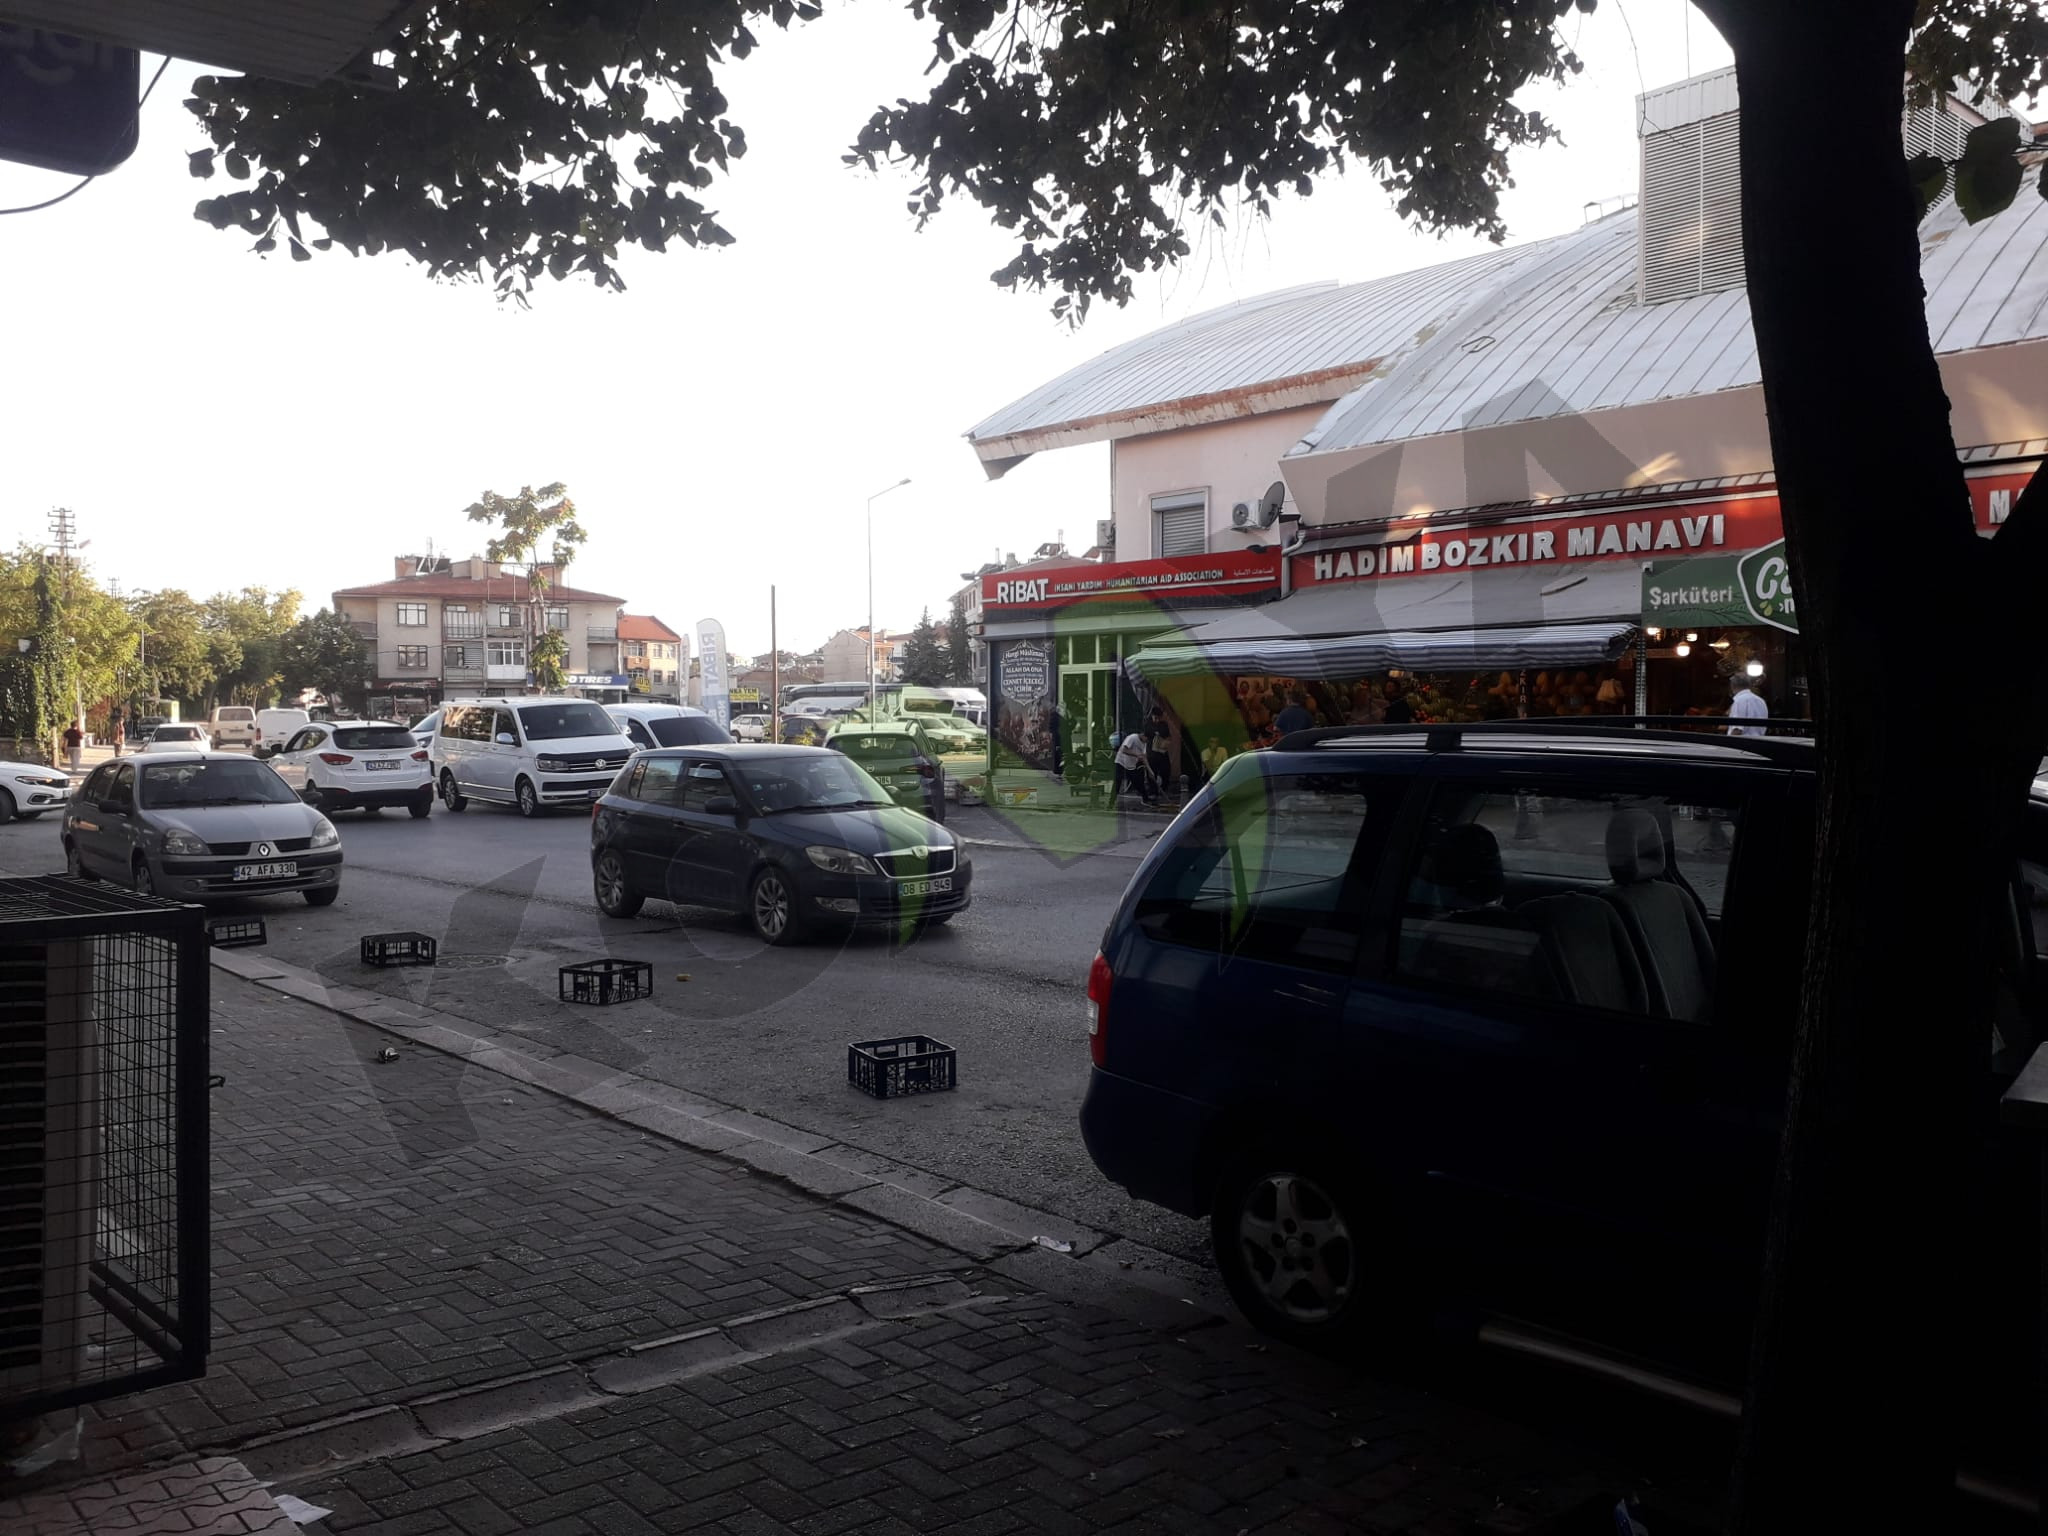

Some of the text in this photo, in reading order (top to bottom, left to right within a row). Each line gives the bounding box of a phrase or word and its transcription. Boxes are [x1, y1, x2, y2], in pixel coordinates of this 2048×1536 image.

[1421, 530, 1556, 570] BOZKIR
[1567, 514, 1726, 557] MANAVI
[1174, 569, 1224, 583] ASSOCIATION
[1649, 585, 1733, 611] Şarküteri
[578, 675, 612, 685] TIRES
[240, 863, 295, 876] 42 AFA 330
[903, 884, 915, 895] 08
[934, 878, 950, 891] 949
